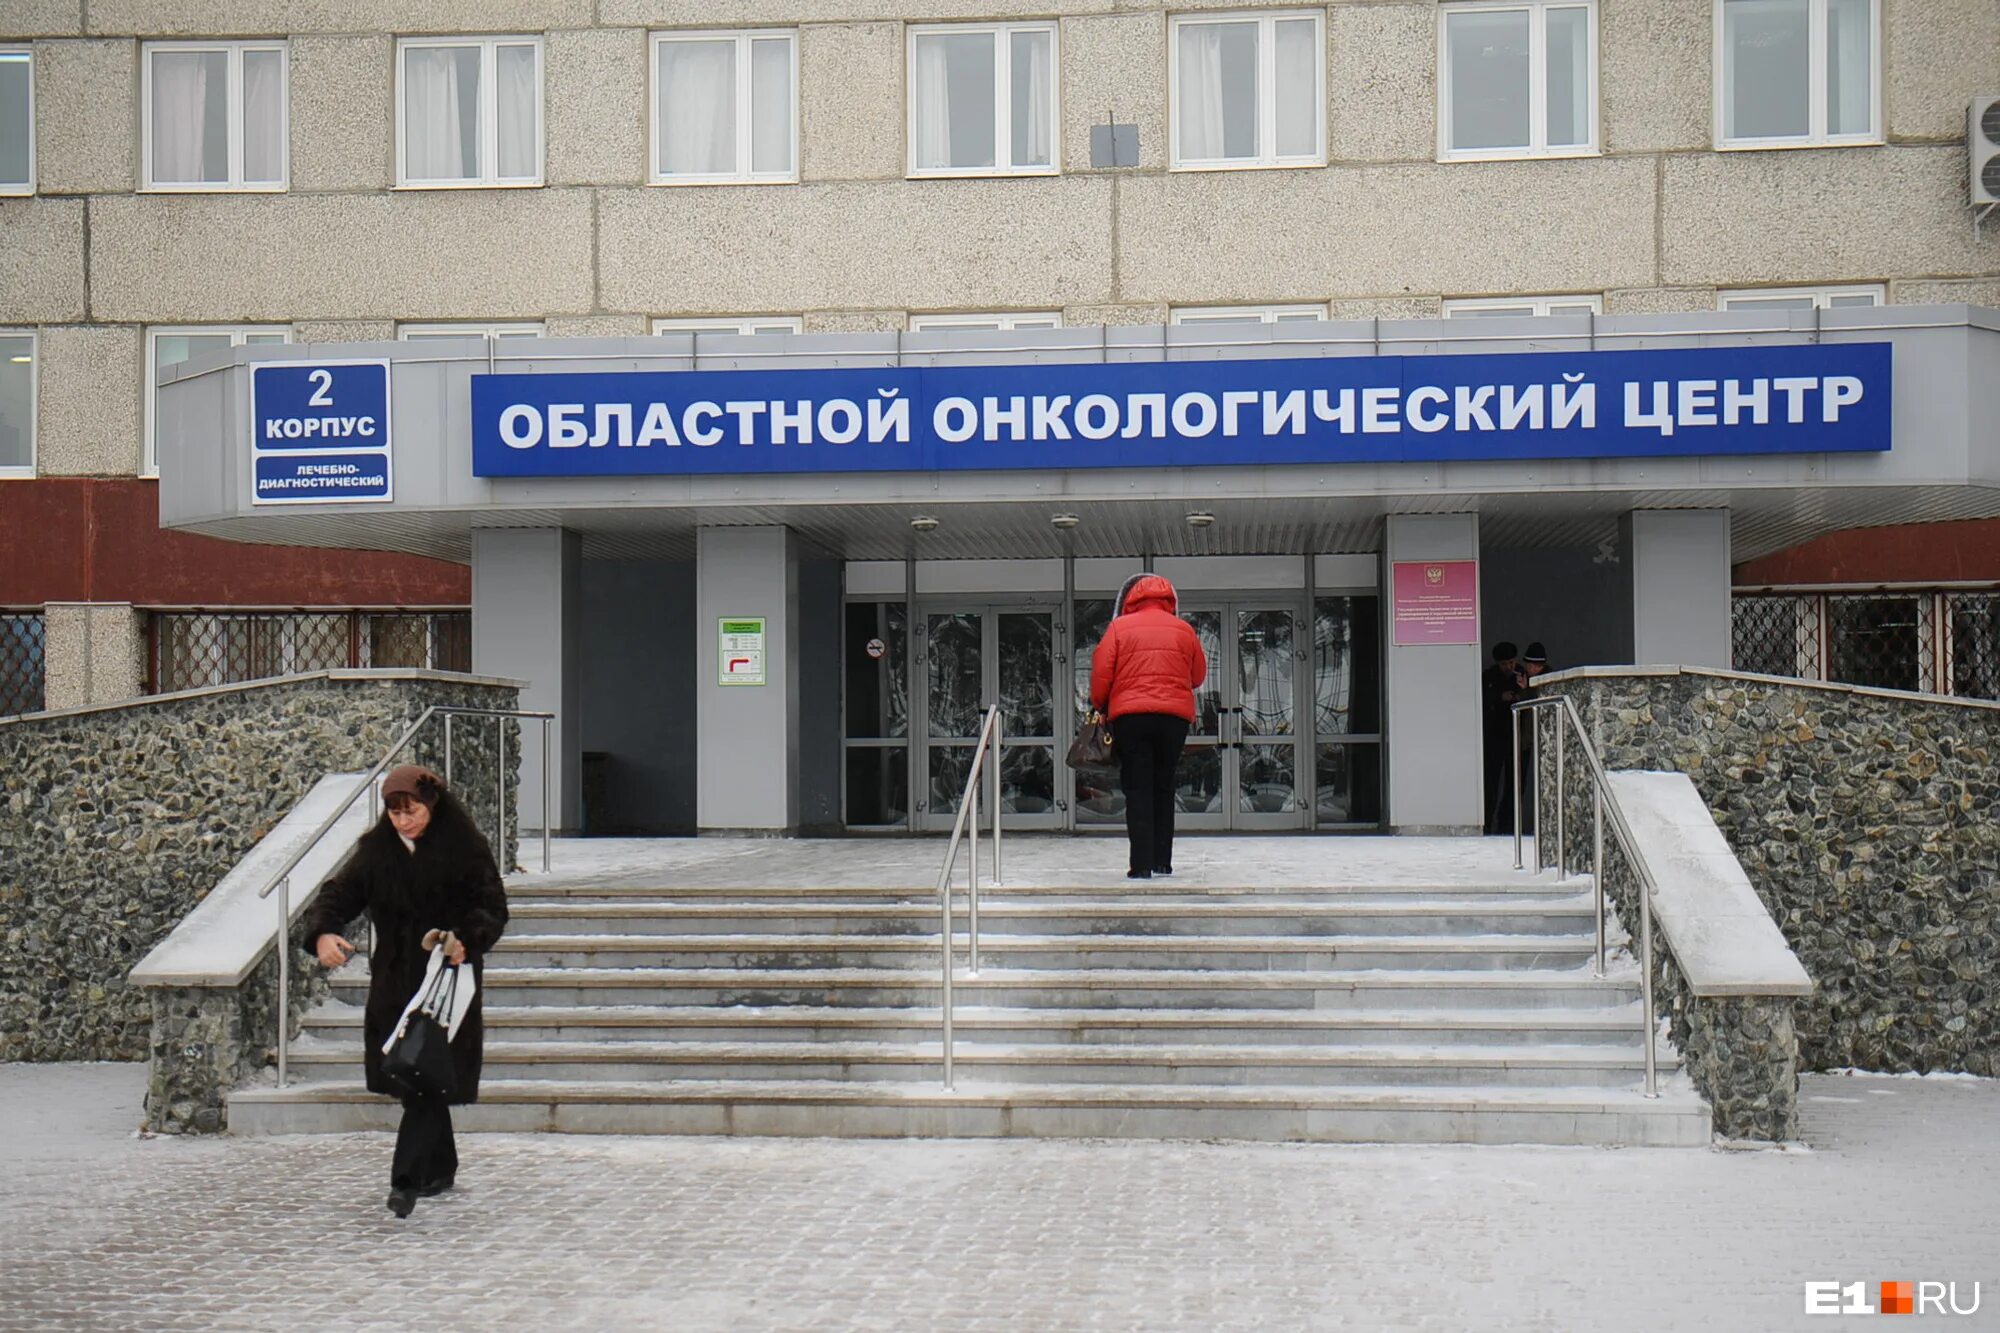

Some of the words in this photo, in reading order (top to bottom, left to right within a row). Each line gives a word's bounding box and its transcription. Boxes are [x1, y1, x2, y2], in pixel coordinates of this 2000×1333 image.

[308, 369, 333, 406] 2
[499, 388, 910, 449] ОБЛАСТНОЙ
[932, 372, 1597, 443] ОНКОЛОГИЧЕСКИЙ
[1624, 376, 1864, 436] ЦЕНТР
[265, 416, 376, 439] КОРПУС
[296, 464, 360, 476] ЛЕЧЕБНО-
[258, 474, 384, 490] ДИАГНОСТИЧЕСКИЙ
